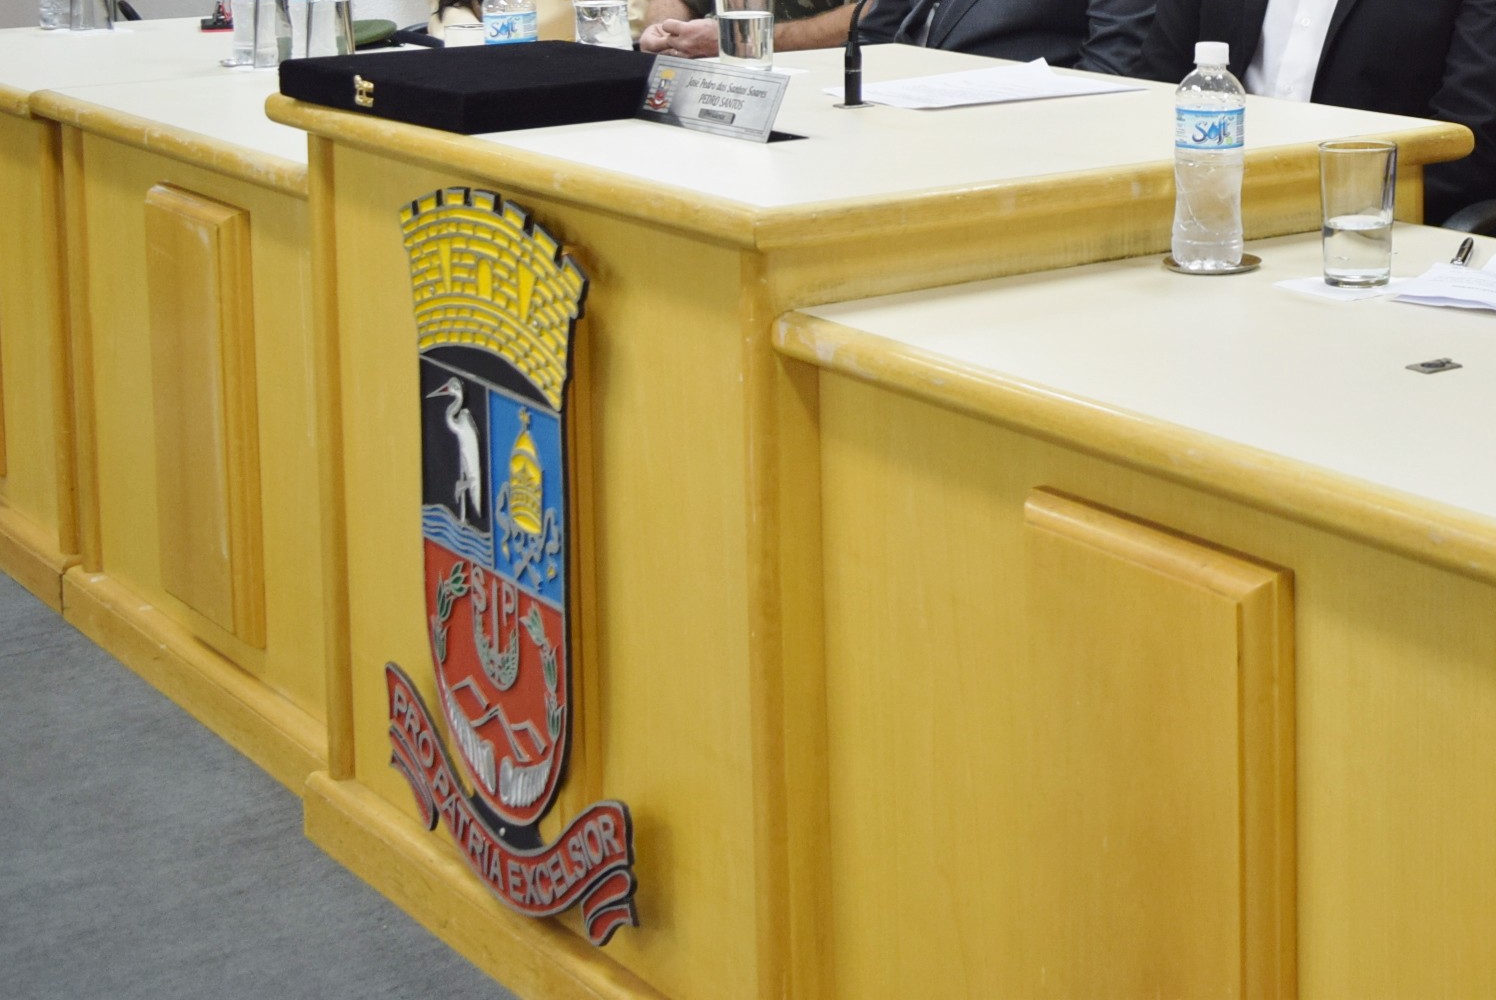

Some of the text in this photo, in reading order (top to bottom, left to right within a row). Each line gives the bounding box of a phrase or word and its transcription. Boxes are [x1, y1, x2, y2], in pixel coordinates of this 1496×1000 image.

[698, 93, 745, 110] PEDRO SANTOS
[393, 683, 624, 905] PRO PATRIA EXCELSIOR
